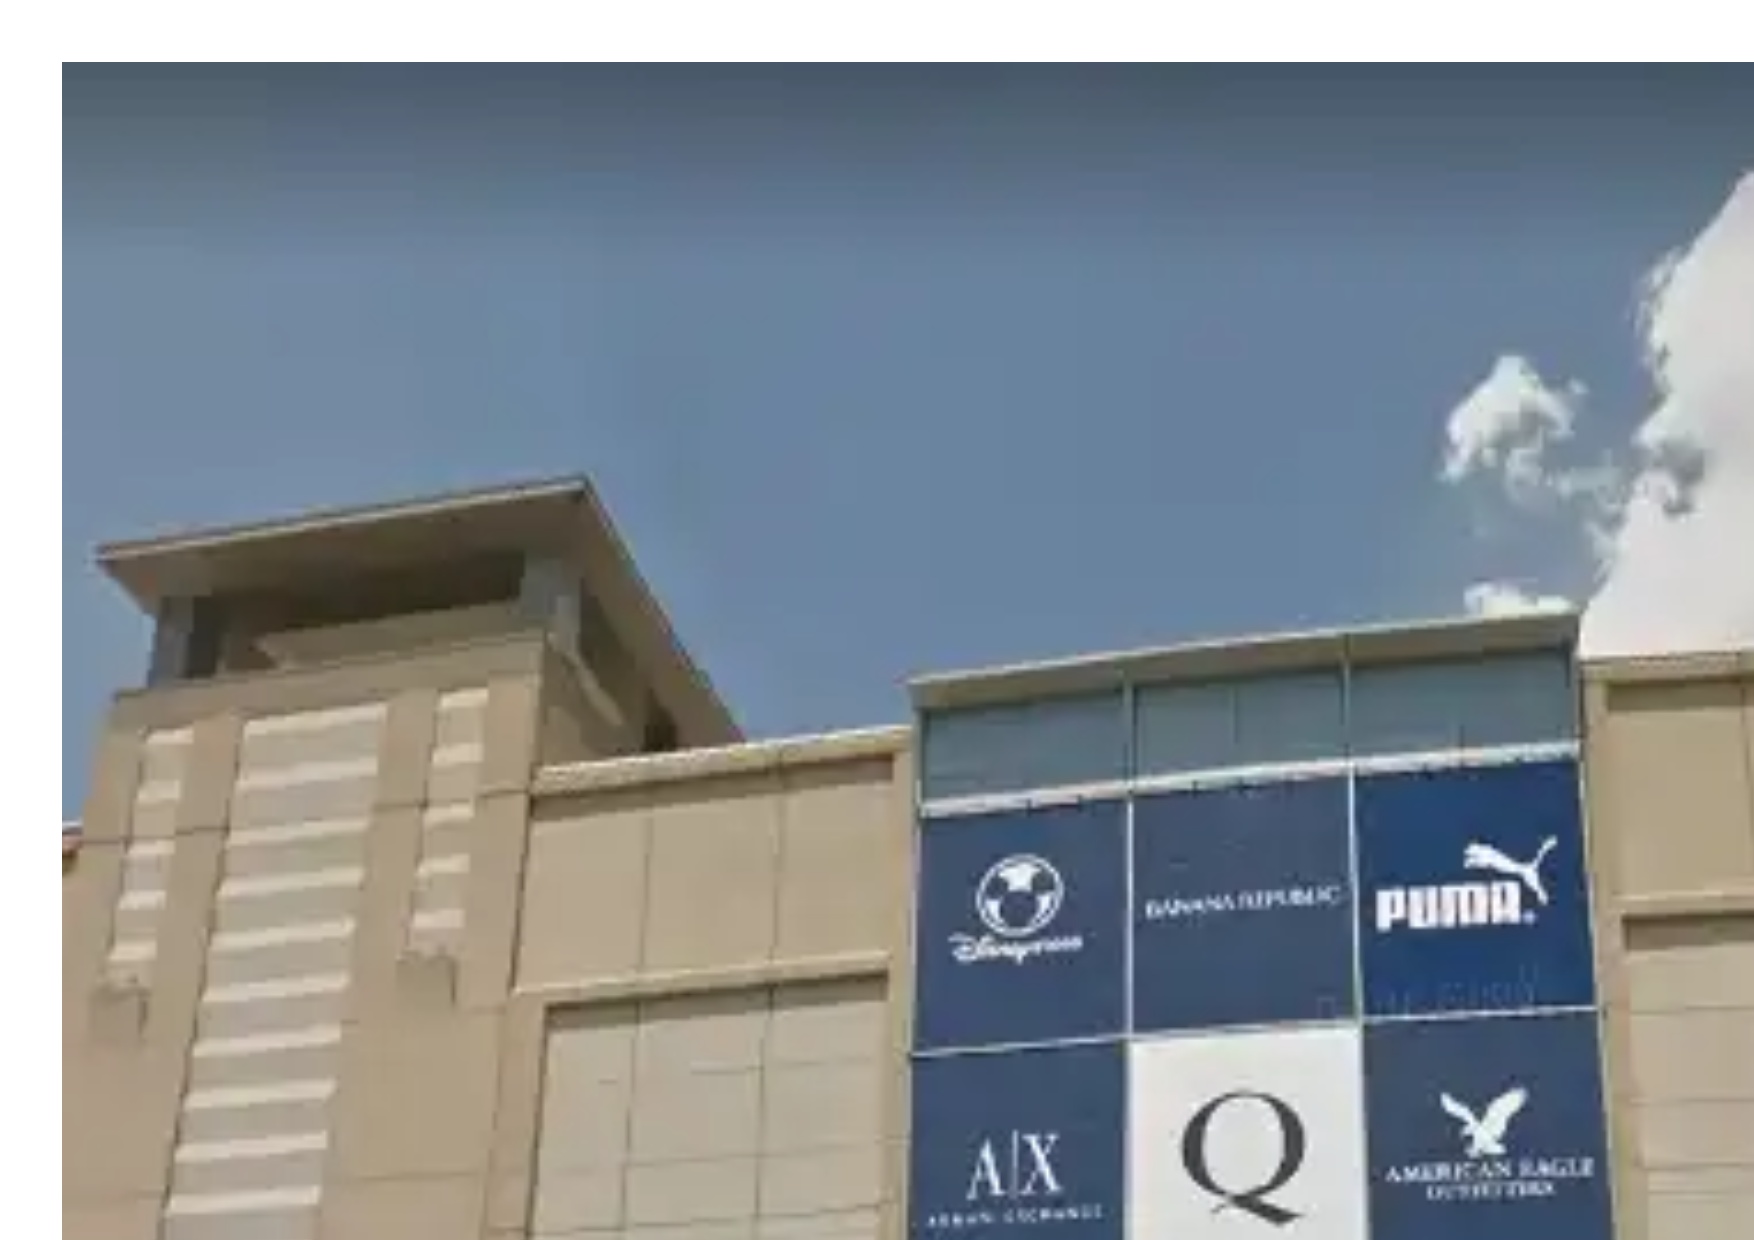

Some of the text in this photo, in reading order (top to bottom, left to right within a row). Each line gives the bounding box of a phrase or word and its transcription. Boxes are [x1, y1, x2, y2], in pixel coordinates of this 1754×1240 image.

[1376, 880, 1521, 934] PUMA
[1181, 1090, 1304, 1227] Q
[1385, 1156, 1594, 1183] AMERICAN EAGLE
